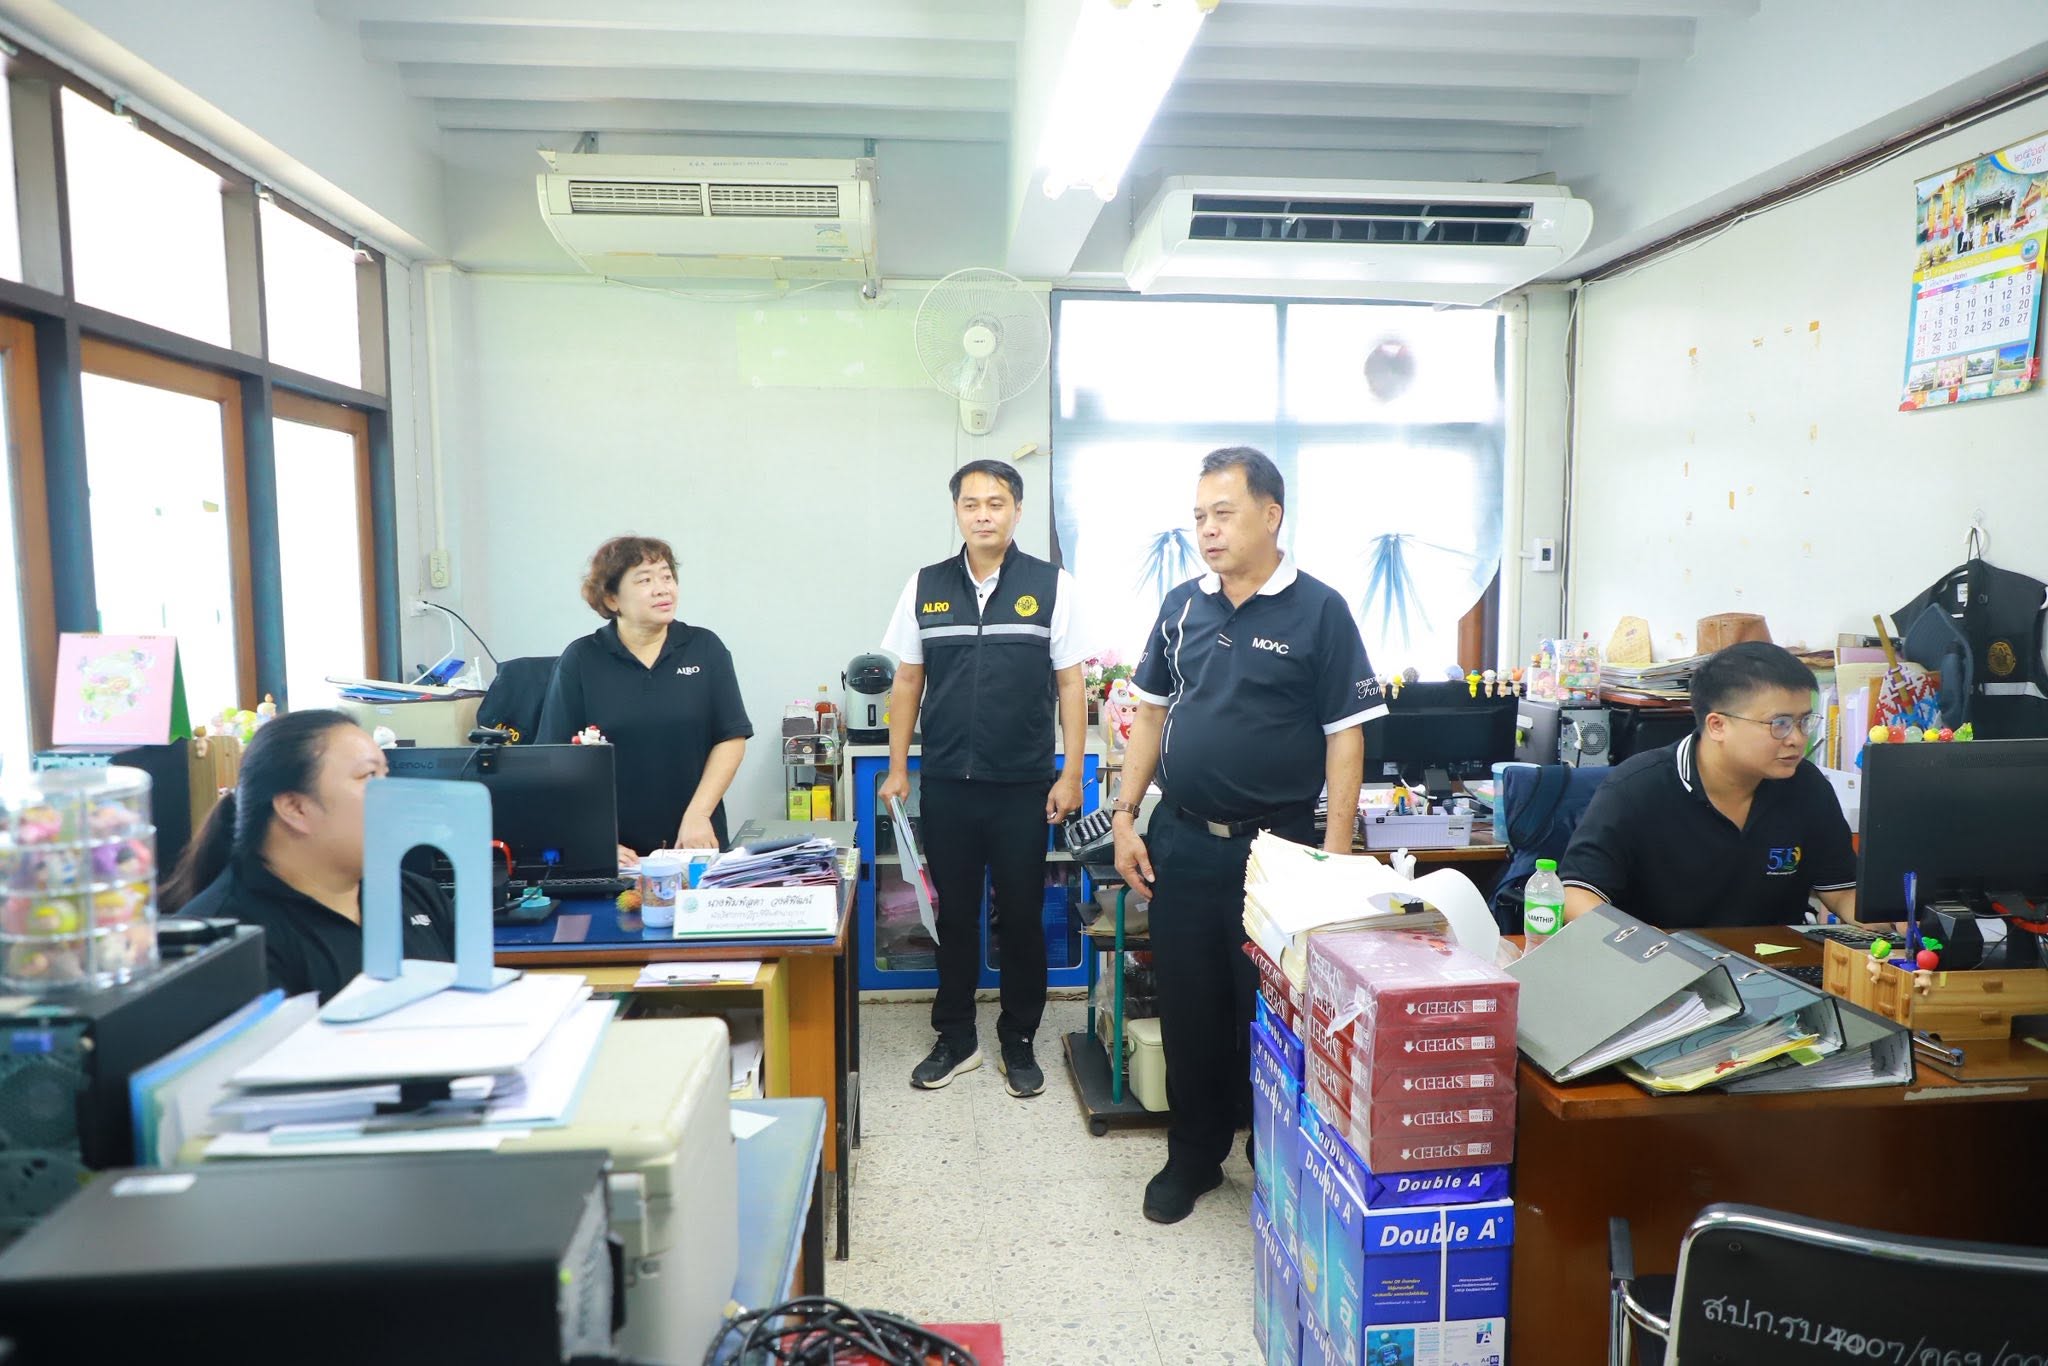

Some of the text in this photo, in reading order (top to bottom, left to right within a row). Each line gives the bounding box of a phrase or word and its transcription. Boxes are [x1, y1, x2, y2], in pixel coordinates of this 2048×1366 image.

[2022, 155, 2042, 169] 2026
[1955, 290, 1960, 299] 2
[1989, 281, 1994, 289] 4
[2008, 276, 2013, 285] 5
[2027, 271, 2032, 280] 6
[1919, 323, 1927, 332] 14
[1935, 319, 1942, 329] 15
[1950, 315, 1958, 325] 16
[1966, 311, 1975, 321] 17
[1983, 308, 1993, 317] 18
[2019, 299, 2029, 310] 20
[1924, 285, 2031, 319] 7 8 9 10 11 12 13
[1918, 312, 2028, 345] 21 22 23 24 25 26 27
[1931, 345, 1941, 355] 29
[1947, 341, 1957, 351] 30
[922, 602, 950, 613] ALRO
[1252, 637, 1289, 654] MOAC
[1417, 1000, 1466, 1014] SPEED
[1263, 1012, 1289, 1058] Double A
[1415, 1037, 1465, 1052] SPEED
[1264, 1050, 1287, 1089] Double
[1414, 1075, 1464, 1090] SPEED
[1254, 1067, 1290, 1127] Double A
[1414, 1110, 1462, 1126] SPEED
[1313, 1119, 1345, 1167] Double
[1412, 1144, 1461, 1160] SPEED
[1305, 1149, 1351, 1224] Double A
[1397, 1173, 1481, 1193] Double A
[1379, 1218, 1496, 1247] Double A
[1256, 1212, 1290, 1285] Double A
